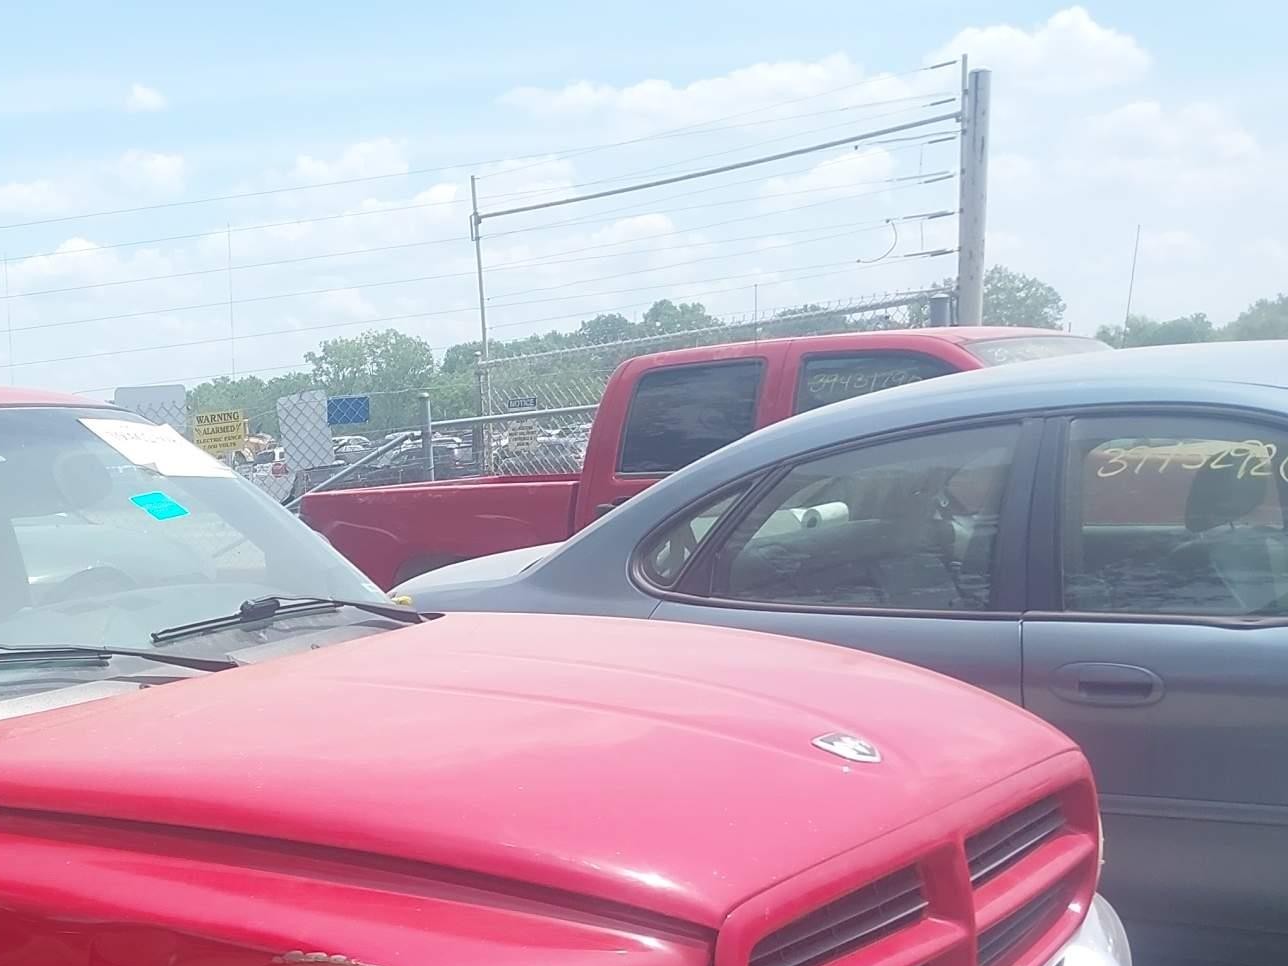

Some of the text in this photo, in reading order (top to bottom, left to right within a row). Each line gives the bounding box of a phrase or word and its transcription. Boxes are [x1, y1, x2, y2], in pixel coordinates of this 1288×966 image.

[509, 399, 534, 408] NOTICE
[196, 411, 240, 424] WARNING
[202, 425, 235, 435] ALARMED
